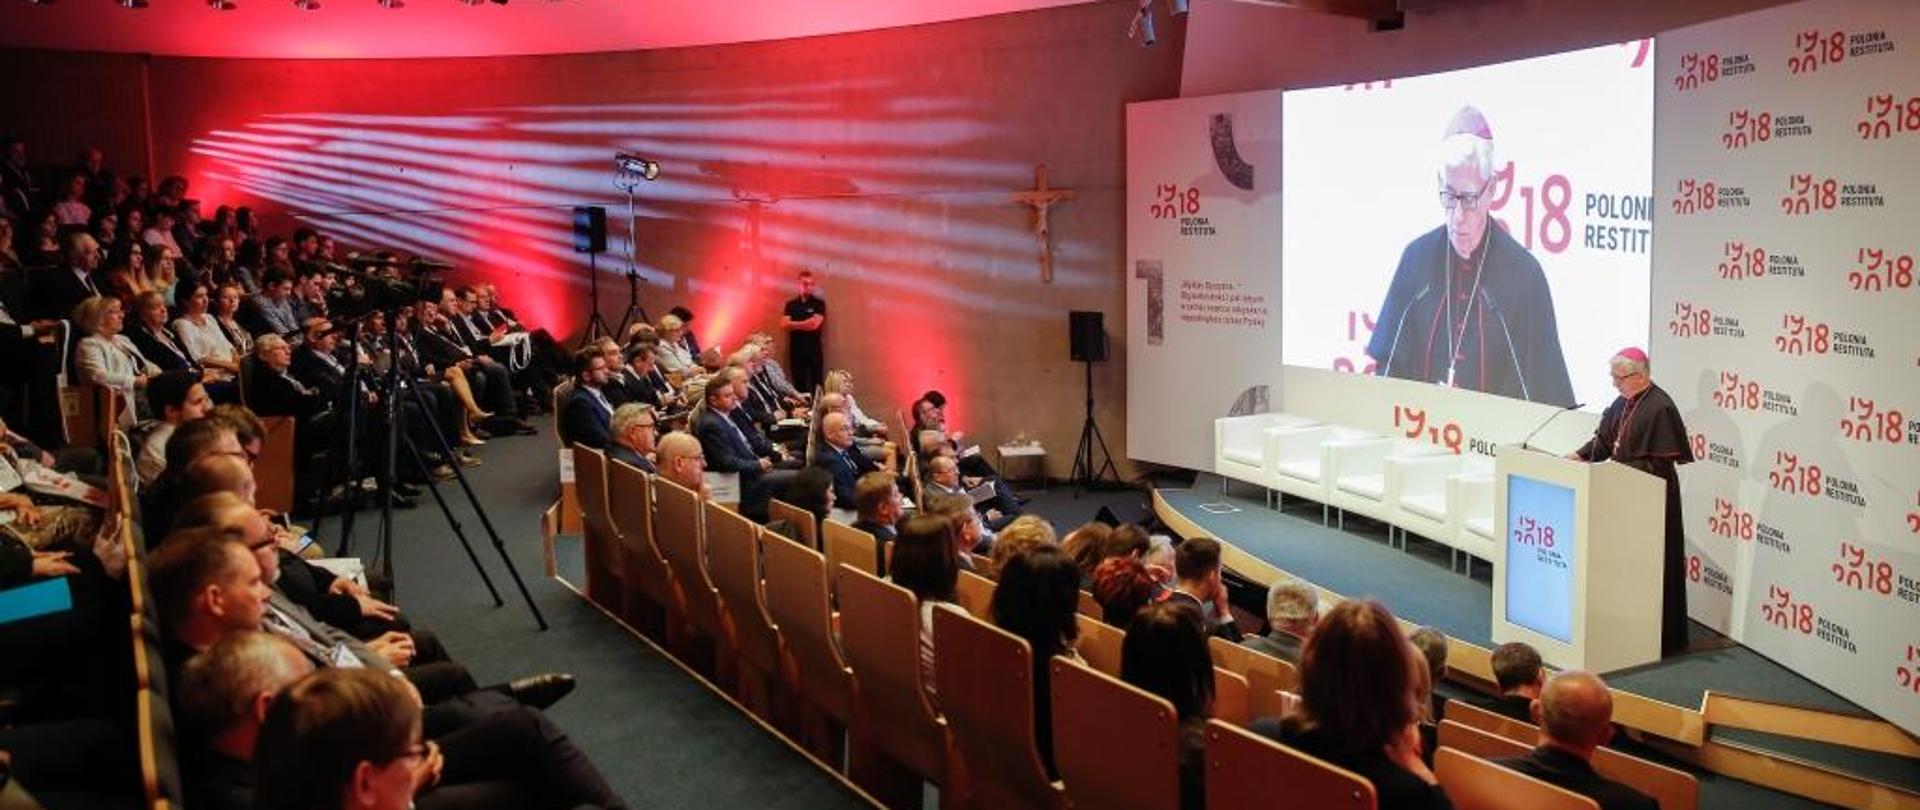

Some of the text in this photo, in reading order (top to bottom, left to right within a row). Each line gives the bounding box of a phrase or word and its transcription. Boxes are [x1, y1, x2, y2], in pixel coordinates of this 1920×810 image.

[1850, 30, 1885, 44] POLONIA
[1722, 54, 1749, 66] POLONIA
[1775, 115, 1804, 126] POLONIA
[1718, 187, 1745, 196] POLONIA
[1842, 184, 1876, 195] POLONIA
[1181, 217, 1209, 226] POLONIA
[1585, 224, 1651, 254] RESTIT
[1769, 255, 1799, 265] POLONIA
[1833, 332, 1867, 345] POLONIA
[1763, 390, 1792, 404] POLONIA
[1826, 476, 1859, 492] POLONIA
[1756, 523, 1785, 540] POLONIA
[1817, 616, 1850, 639] POLONIA
